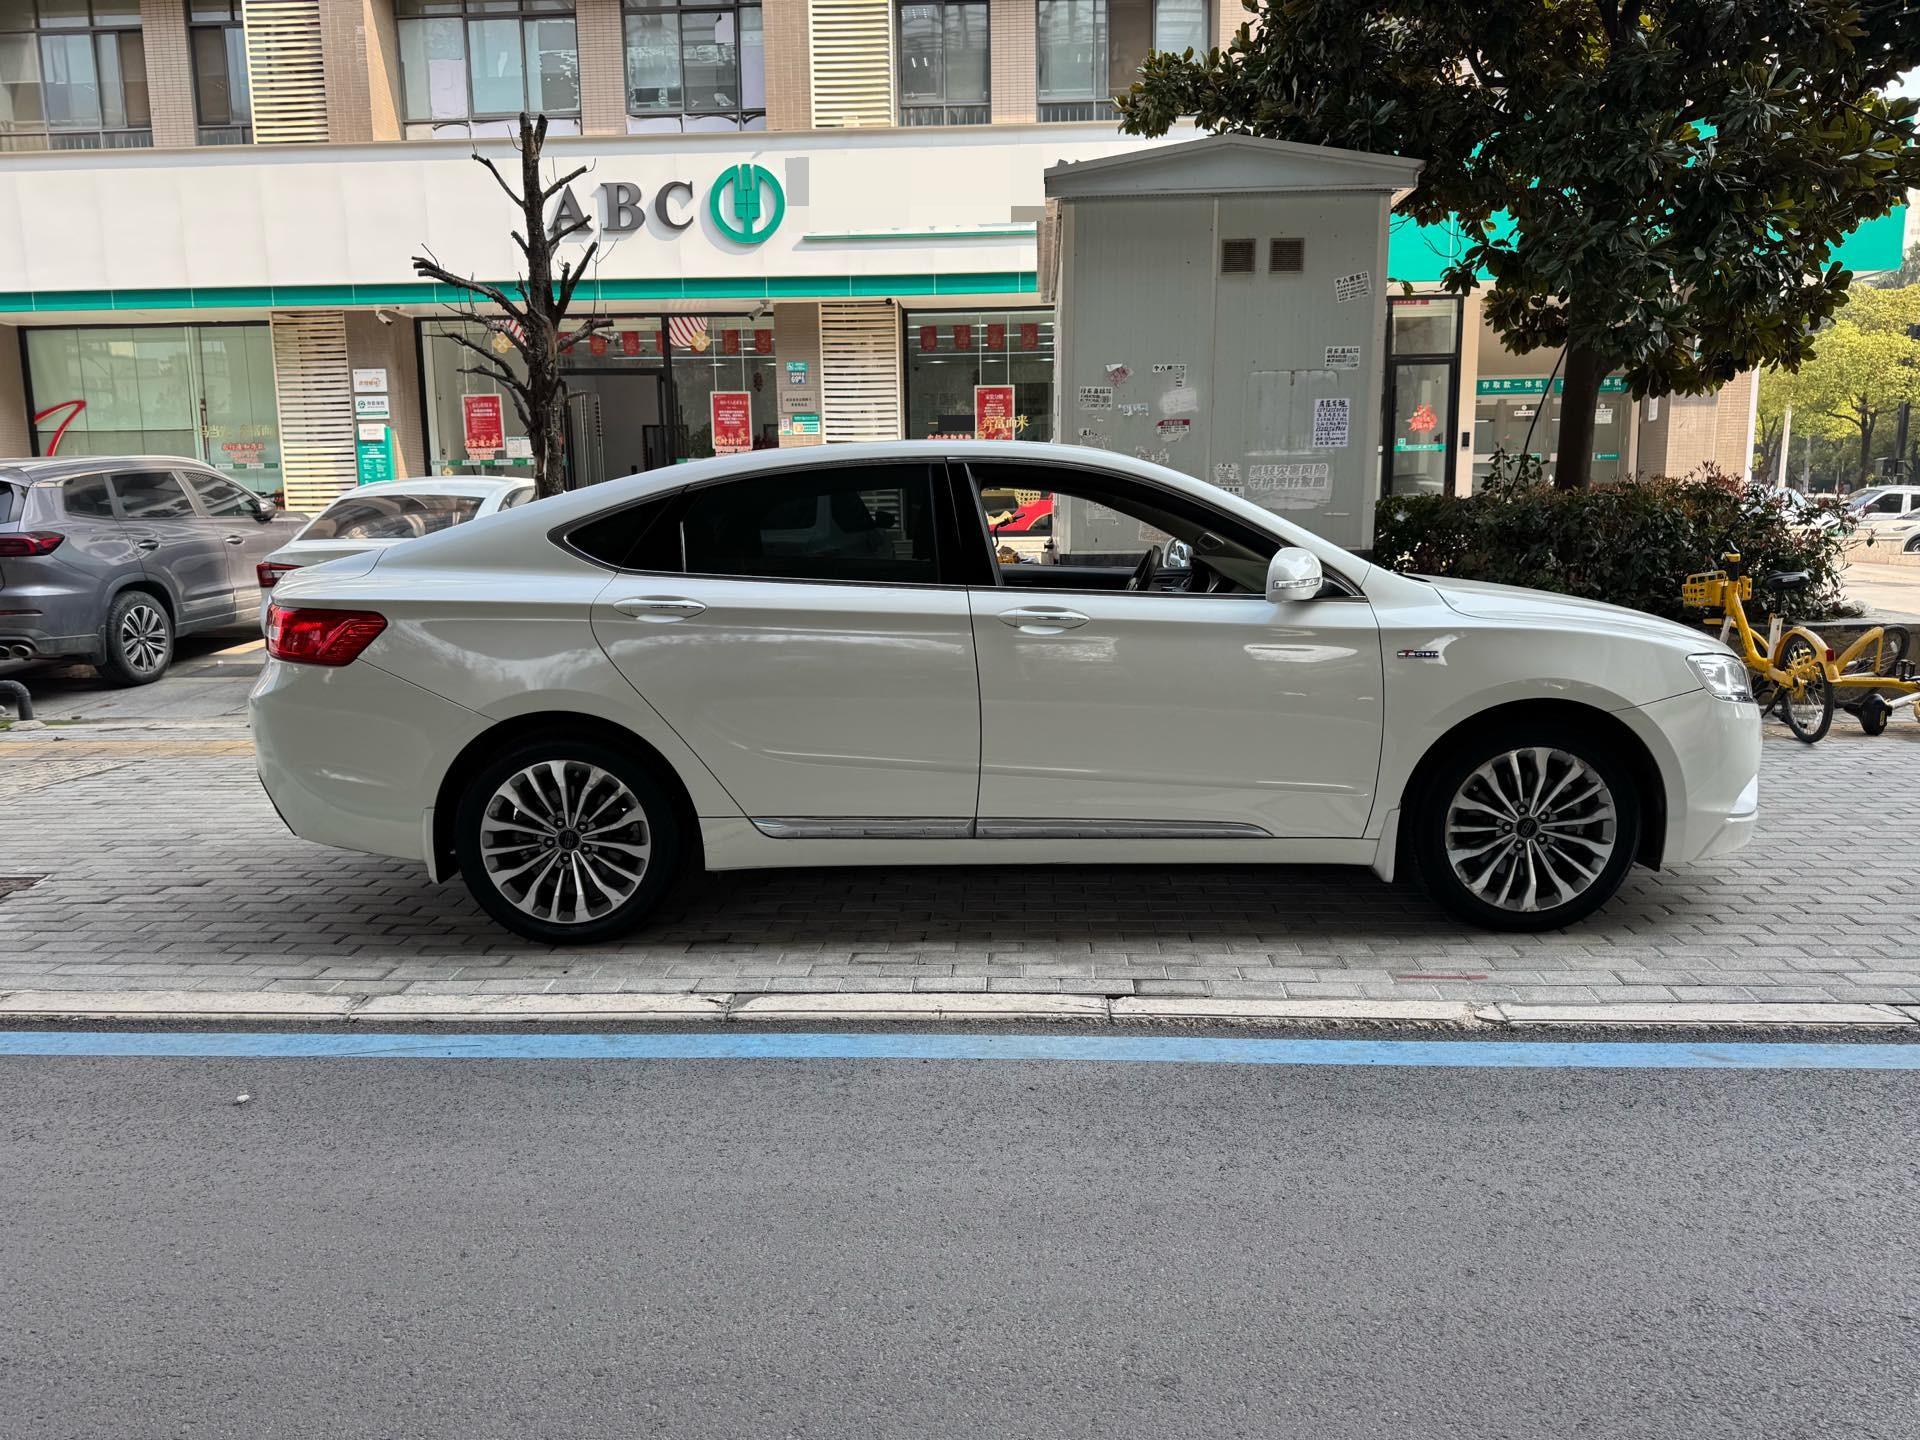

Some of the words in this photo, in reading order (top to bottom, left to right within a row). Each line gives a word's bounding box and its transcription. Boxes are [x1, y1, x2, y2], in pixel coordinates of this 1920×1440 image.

[548, 180, 695, 233] ABC
[1482, 379, 1543, 390] 存取款一体机
